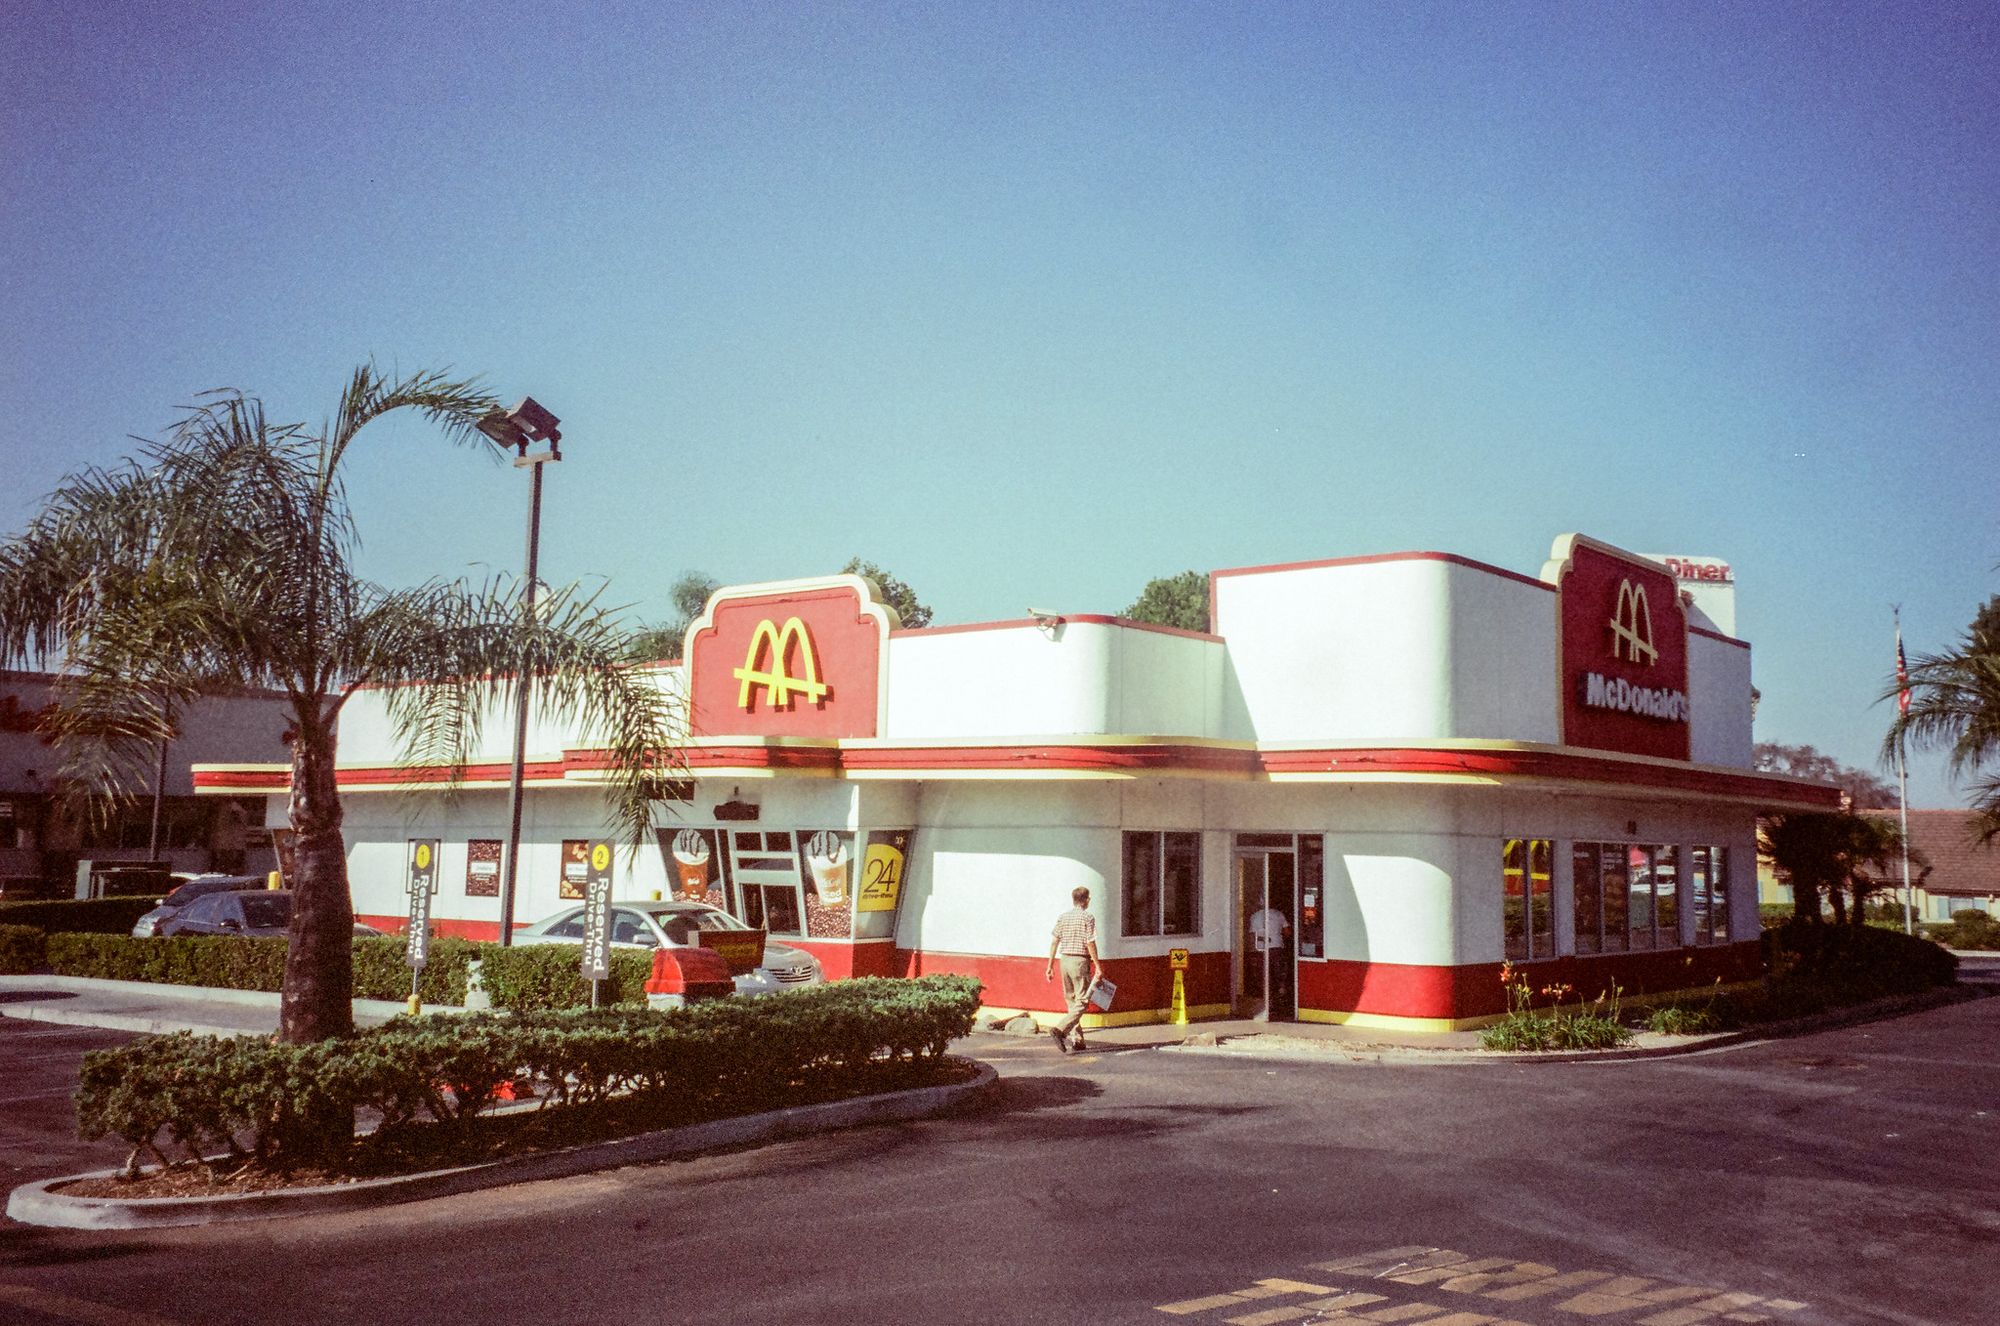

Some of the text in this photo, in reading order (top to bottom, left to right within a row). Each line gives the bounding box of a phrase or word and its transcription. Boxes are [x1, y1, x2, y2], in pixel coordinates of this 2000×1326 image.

[1665, 558, 1730, 582] Diner
[1586, 672, 1689, 722] McDonald's
[864, 858, 896, 892] 24
[408, 879, 420, 955] Drive-Thru
[413, 874, 430, 960] Reserved
[584, 882, 598, 966] Drive-Thru
[593, 877, 609, 972] Reserved
